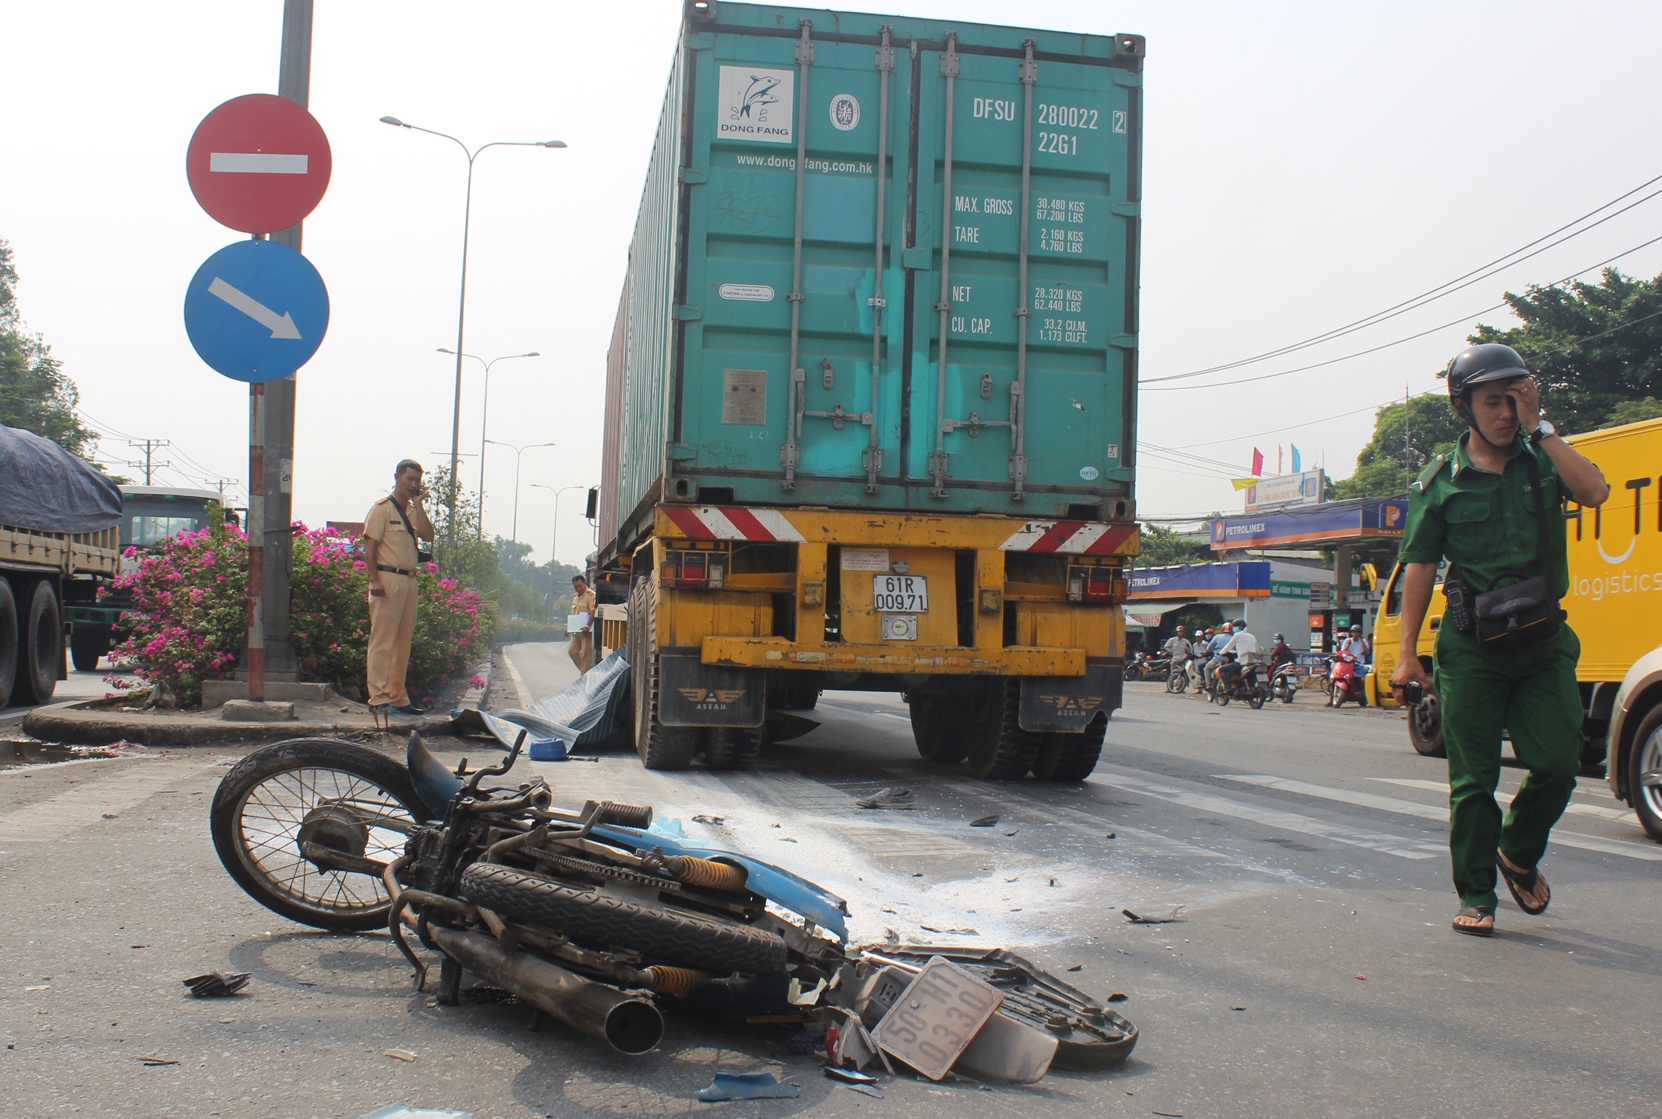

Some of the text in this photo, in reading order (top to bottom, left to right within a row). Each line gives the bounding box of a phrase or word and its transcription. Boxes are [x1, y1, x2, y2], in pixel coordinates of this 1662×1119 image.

[973, 97, 1124, 132] DFSU 280022 2
[721, 124, 789, 136] DONG FANG
[1038, 131, 1078, 156] 22G1
[955, 195, 1013, 215] MAX. GROSS
[1037, 198, 1085, 212] 30.480 KGS
[1036, 209, 1084, 224] 67.200 LBS
[955, 226, 979, 243] TARE
[1041, 228, 1084, 242] 2.160 KGS
[1040, 240, 1083, 253] 4.760 LBS
[952, 286, 972, 302] NET
[1035, 287, 1083, 301] 28.320 KGS
[1034, 299, 1082, 313] 62.440 LBS
[951, 317, 993, 335] CU. CAP.
[1044, 318, 1063, 331] 33.2
[1039, 330, 1062, 342] 1.173
[1226, 522, 1266, 536] PETROLIMEX
[885, 577, 914, 593] 61R
[1127, 577, 1160, 587] PETROLIMEX
[1573, 569, 1662, 601] logistics
[875, 593, 924, 610] 009.71
[918, 990, 989, 1064] 0330
